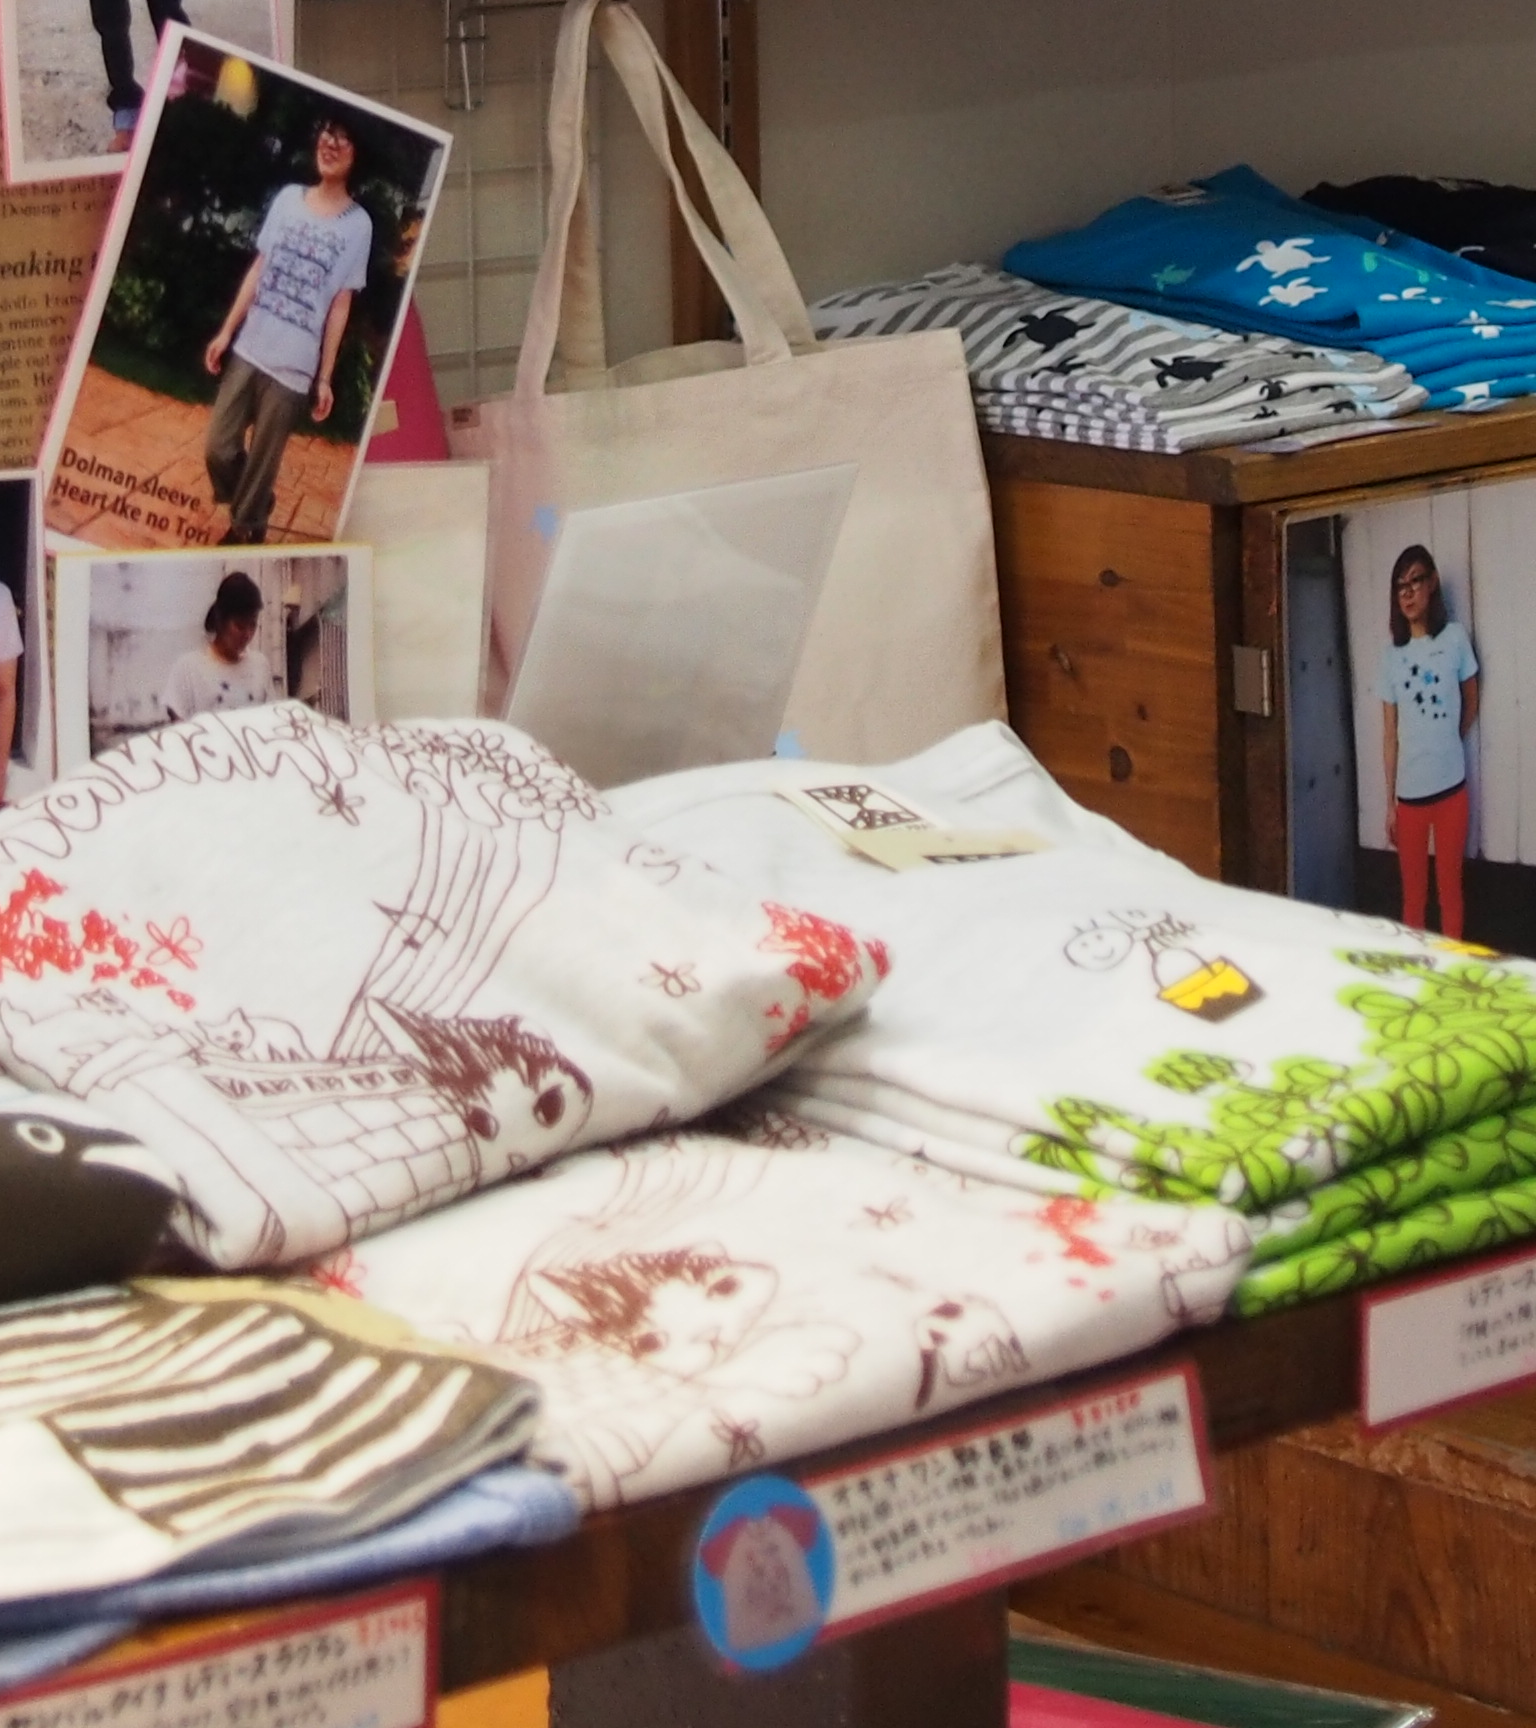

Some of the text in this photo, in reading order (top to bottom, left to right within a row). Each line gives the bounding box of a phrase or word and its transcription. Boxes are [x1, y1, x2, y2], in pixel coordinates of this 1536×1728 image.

[51, 474, 109, 512] Heart
[144, 510, 170, 532] no
[174, 515, 213, 547] Tori
[61, 445, 202, 511] Dolman sleeve
